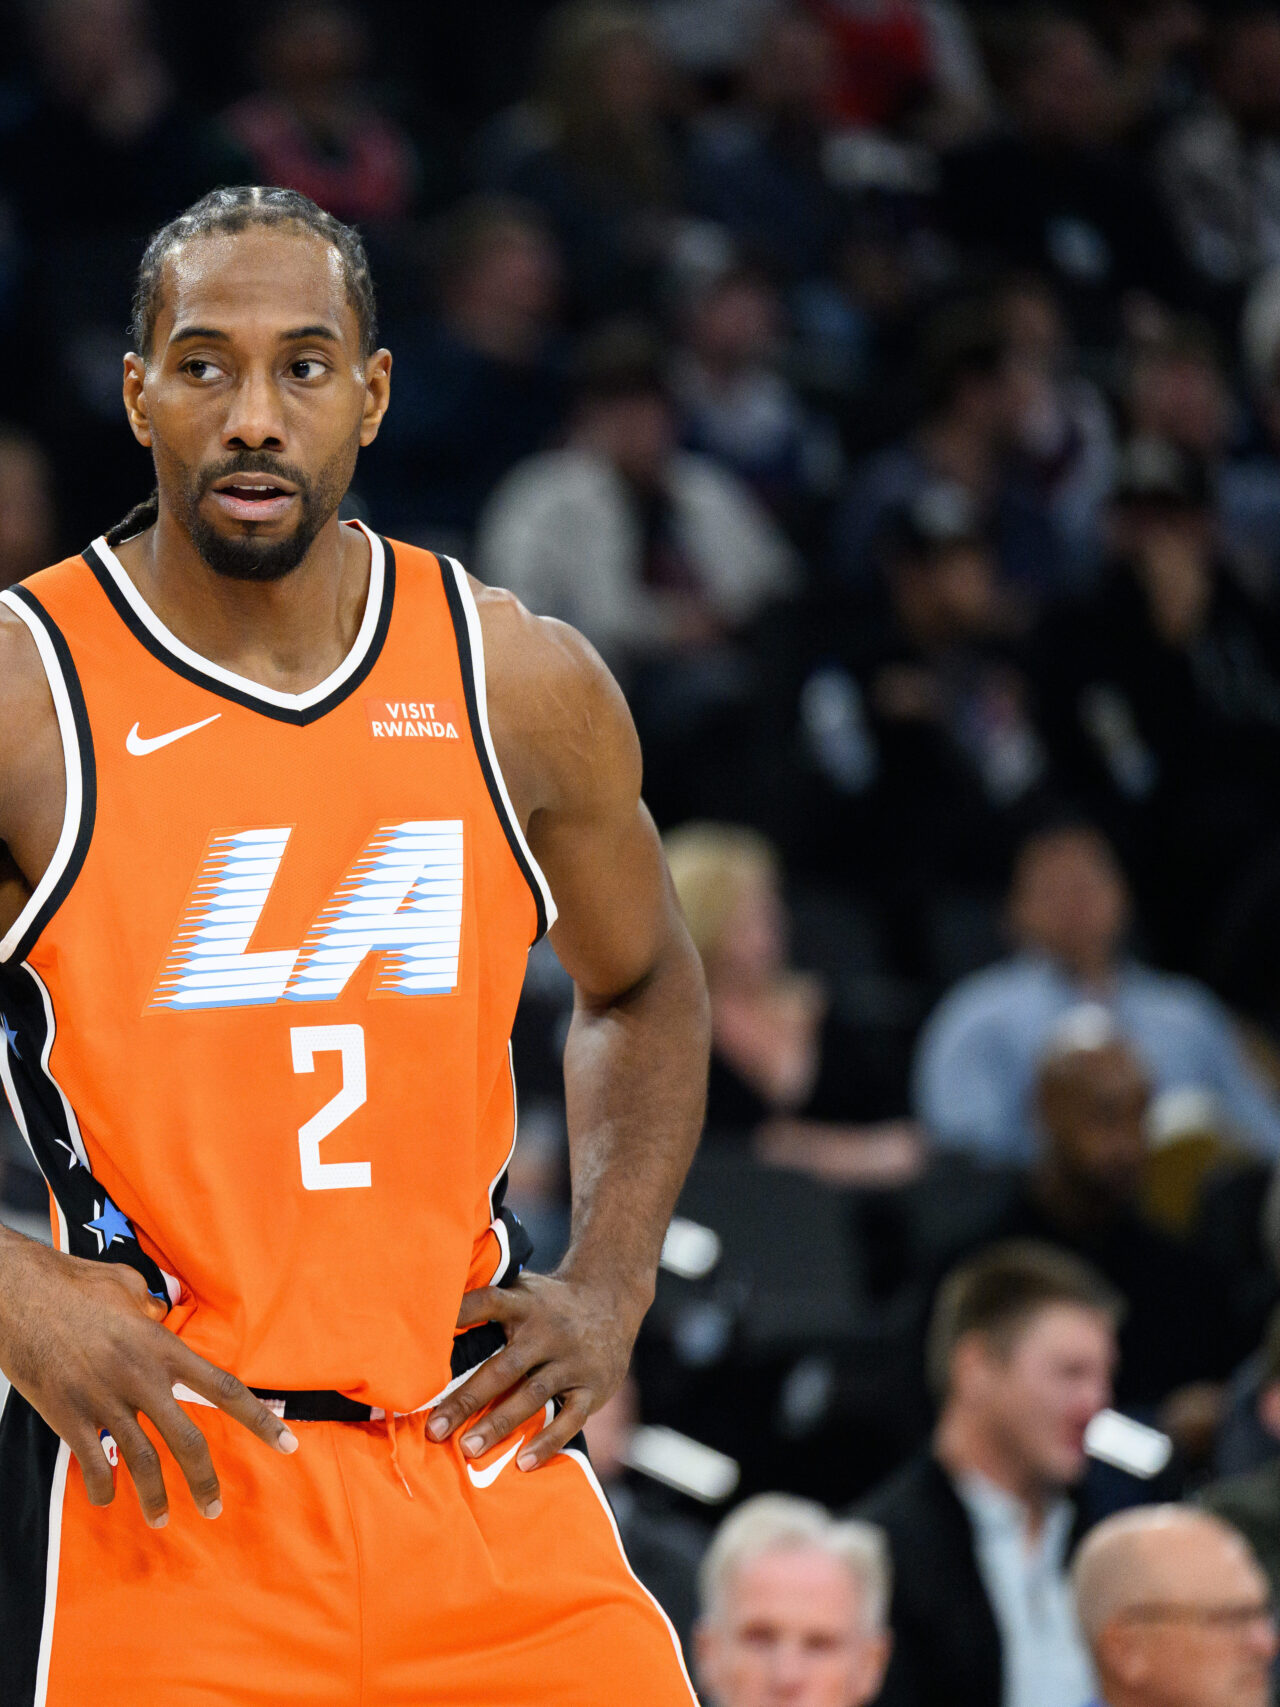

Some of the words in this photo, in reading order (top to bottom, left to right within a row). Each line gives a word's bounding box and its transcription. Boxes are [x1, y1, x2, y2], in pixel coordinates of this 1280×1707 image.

[372, 720, 459, 738] RWANDA
[385, 703, 435, 719] VISIT
[148, 820, 464, 1010] LA
[290, 1024, 372, 1191] 2
